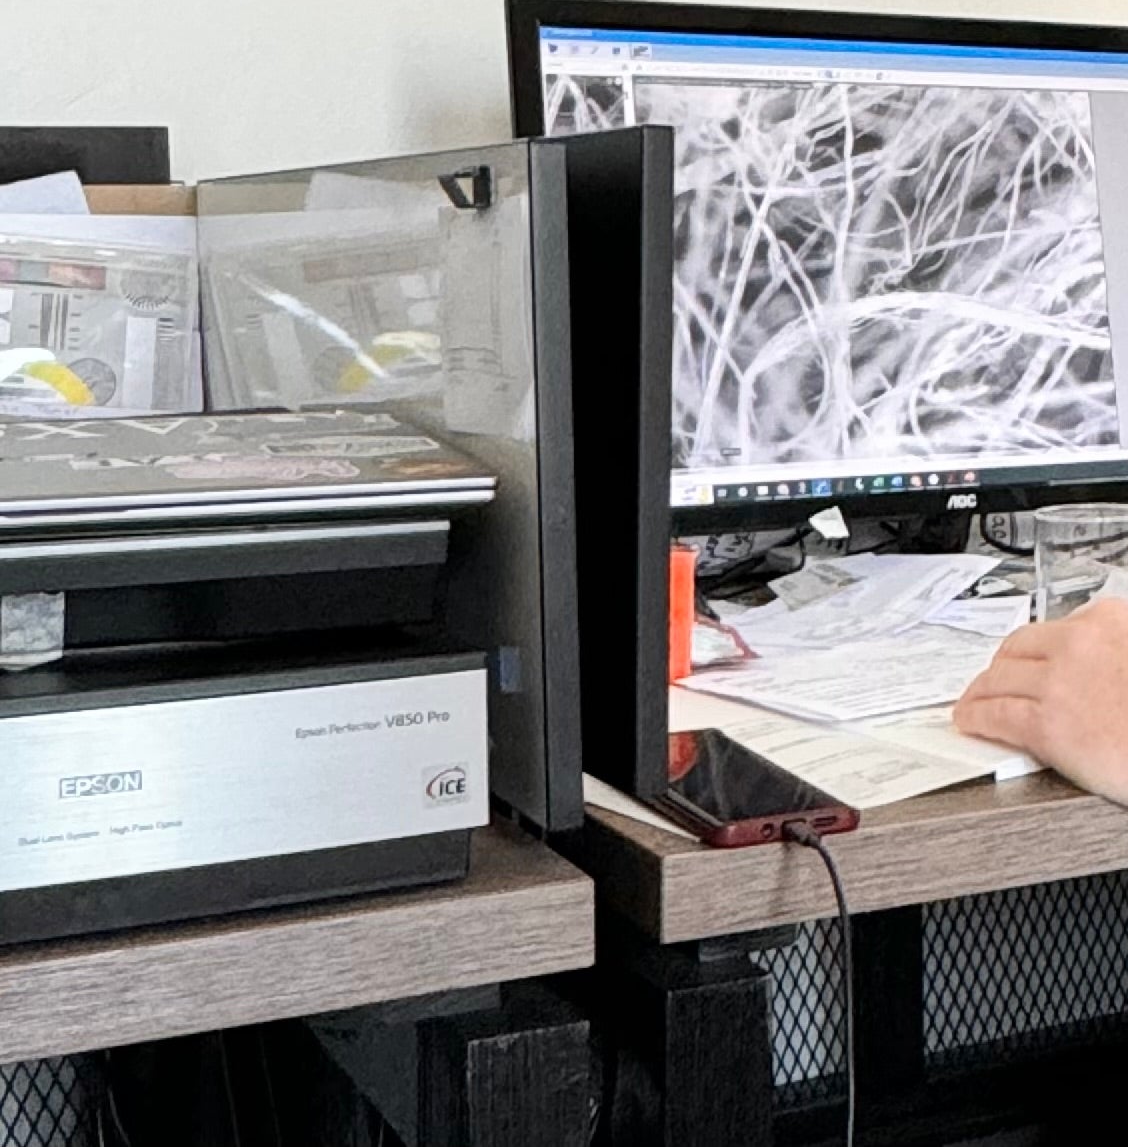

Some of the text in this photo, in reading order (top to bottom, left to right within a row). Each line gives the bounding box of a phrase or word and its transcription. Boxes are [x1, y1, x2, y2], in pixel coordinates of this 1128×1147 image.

[384, 711, 424, 728] V850
[427, 710, 450, 724] Pro
[59, 769, 142, 799] EPSON
[439, 778, 466, 797] ICE
